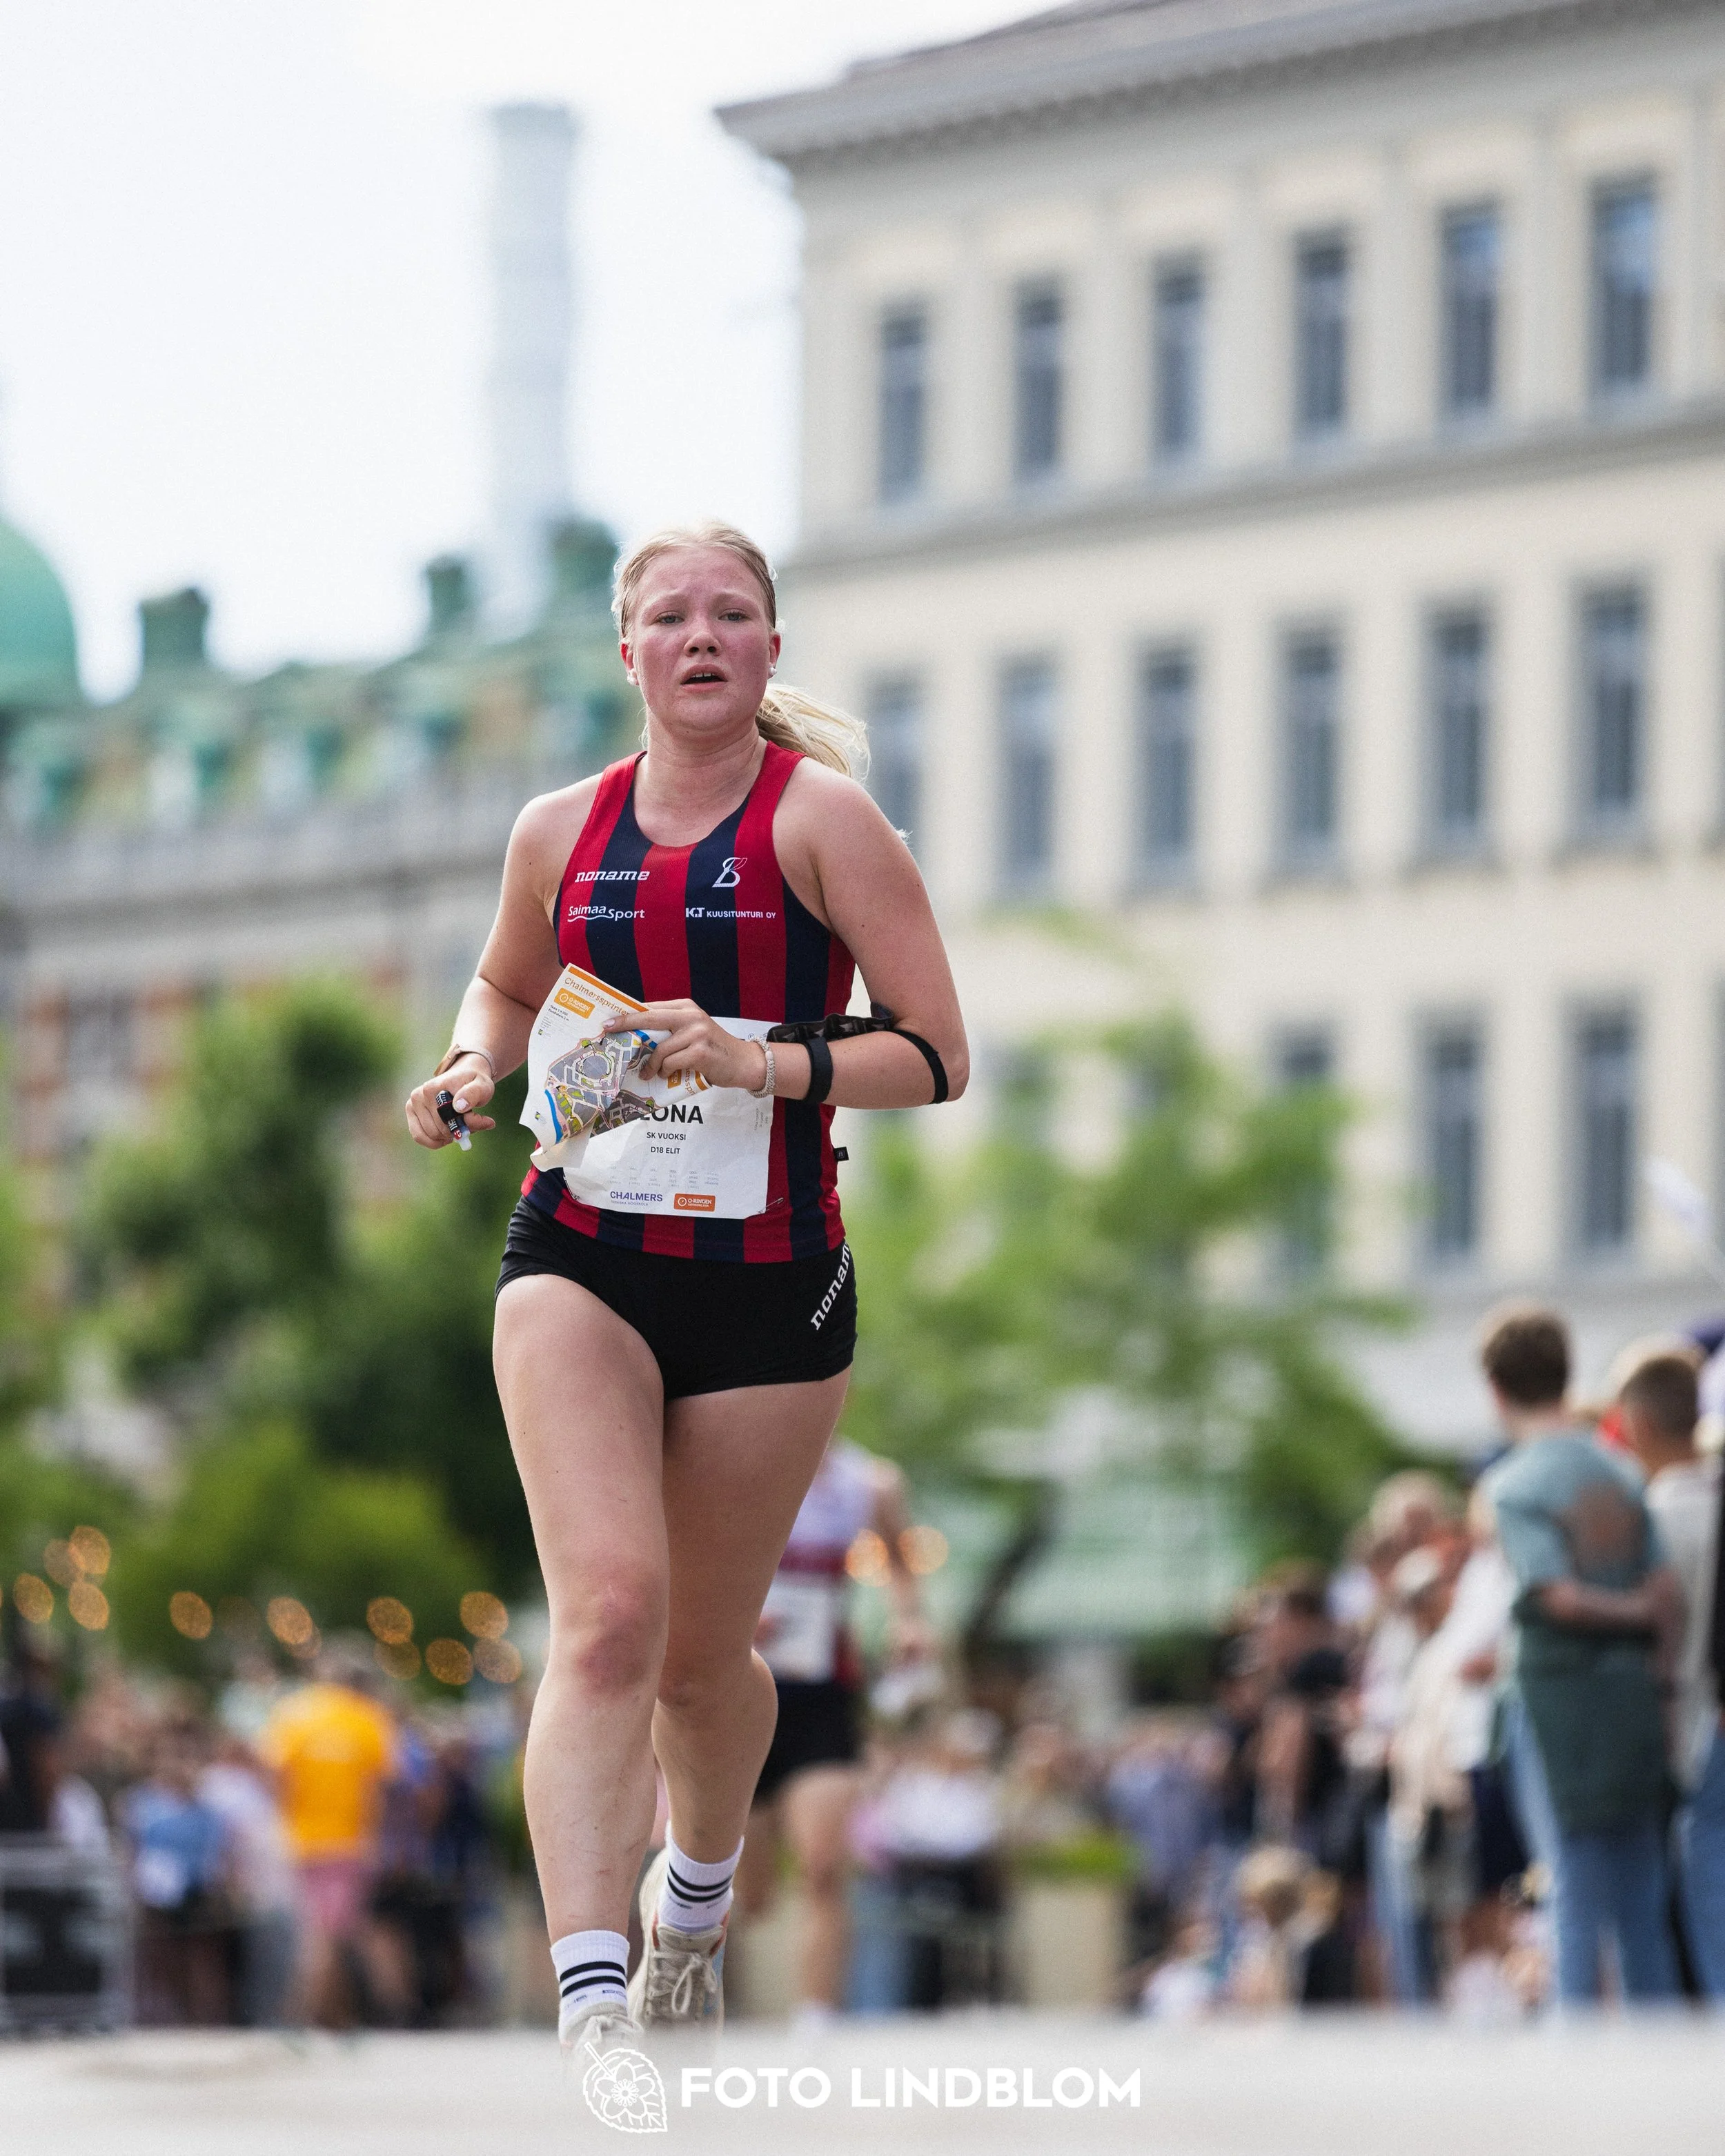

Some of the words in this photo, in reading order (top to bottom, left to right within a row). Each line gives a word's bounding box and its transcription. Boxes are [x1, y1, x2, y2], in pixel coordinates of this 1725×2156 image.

[575, 871, 650, 882] noname
[640, 1104, 704, 1125] ONA
[658, 1132, 687, 1140] VUOKSI
[610, 1191, 663, 1202] CHALMERS
